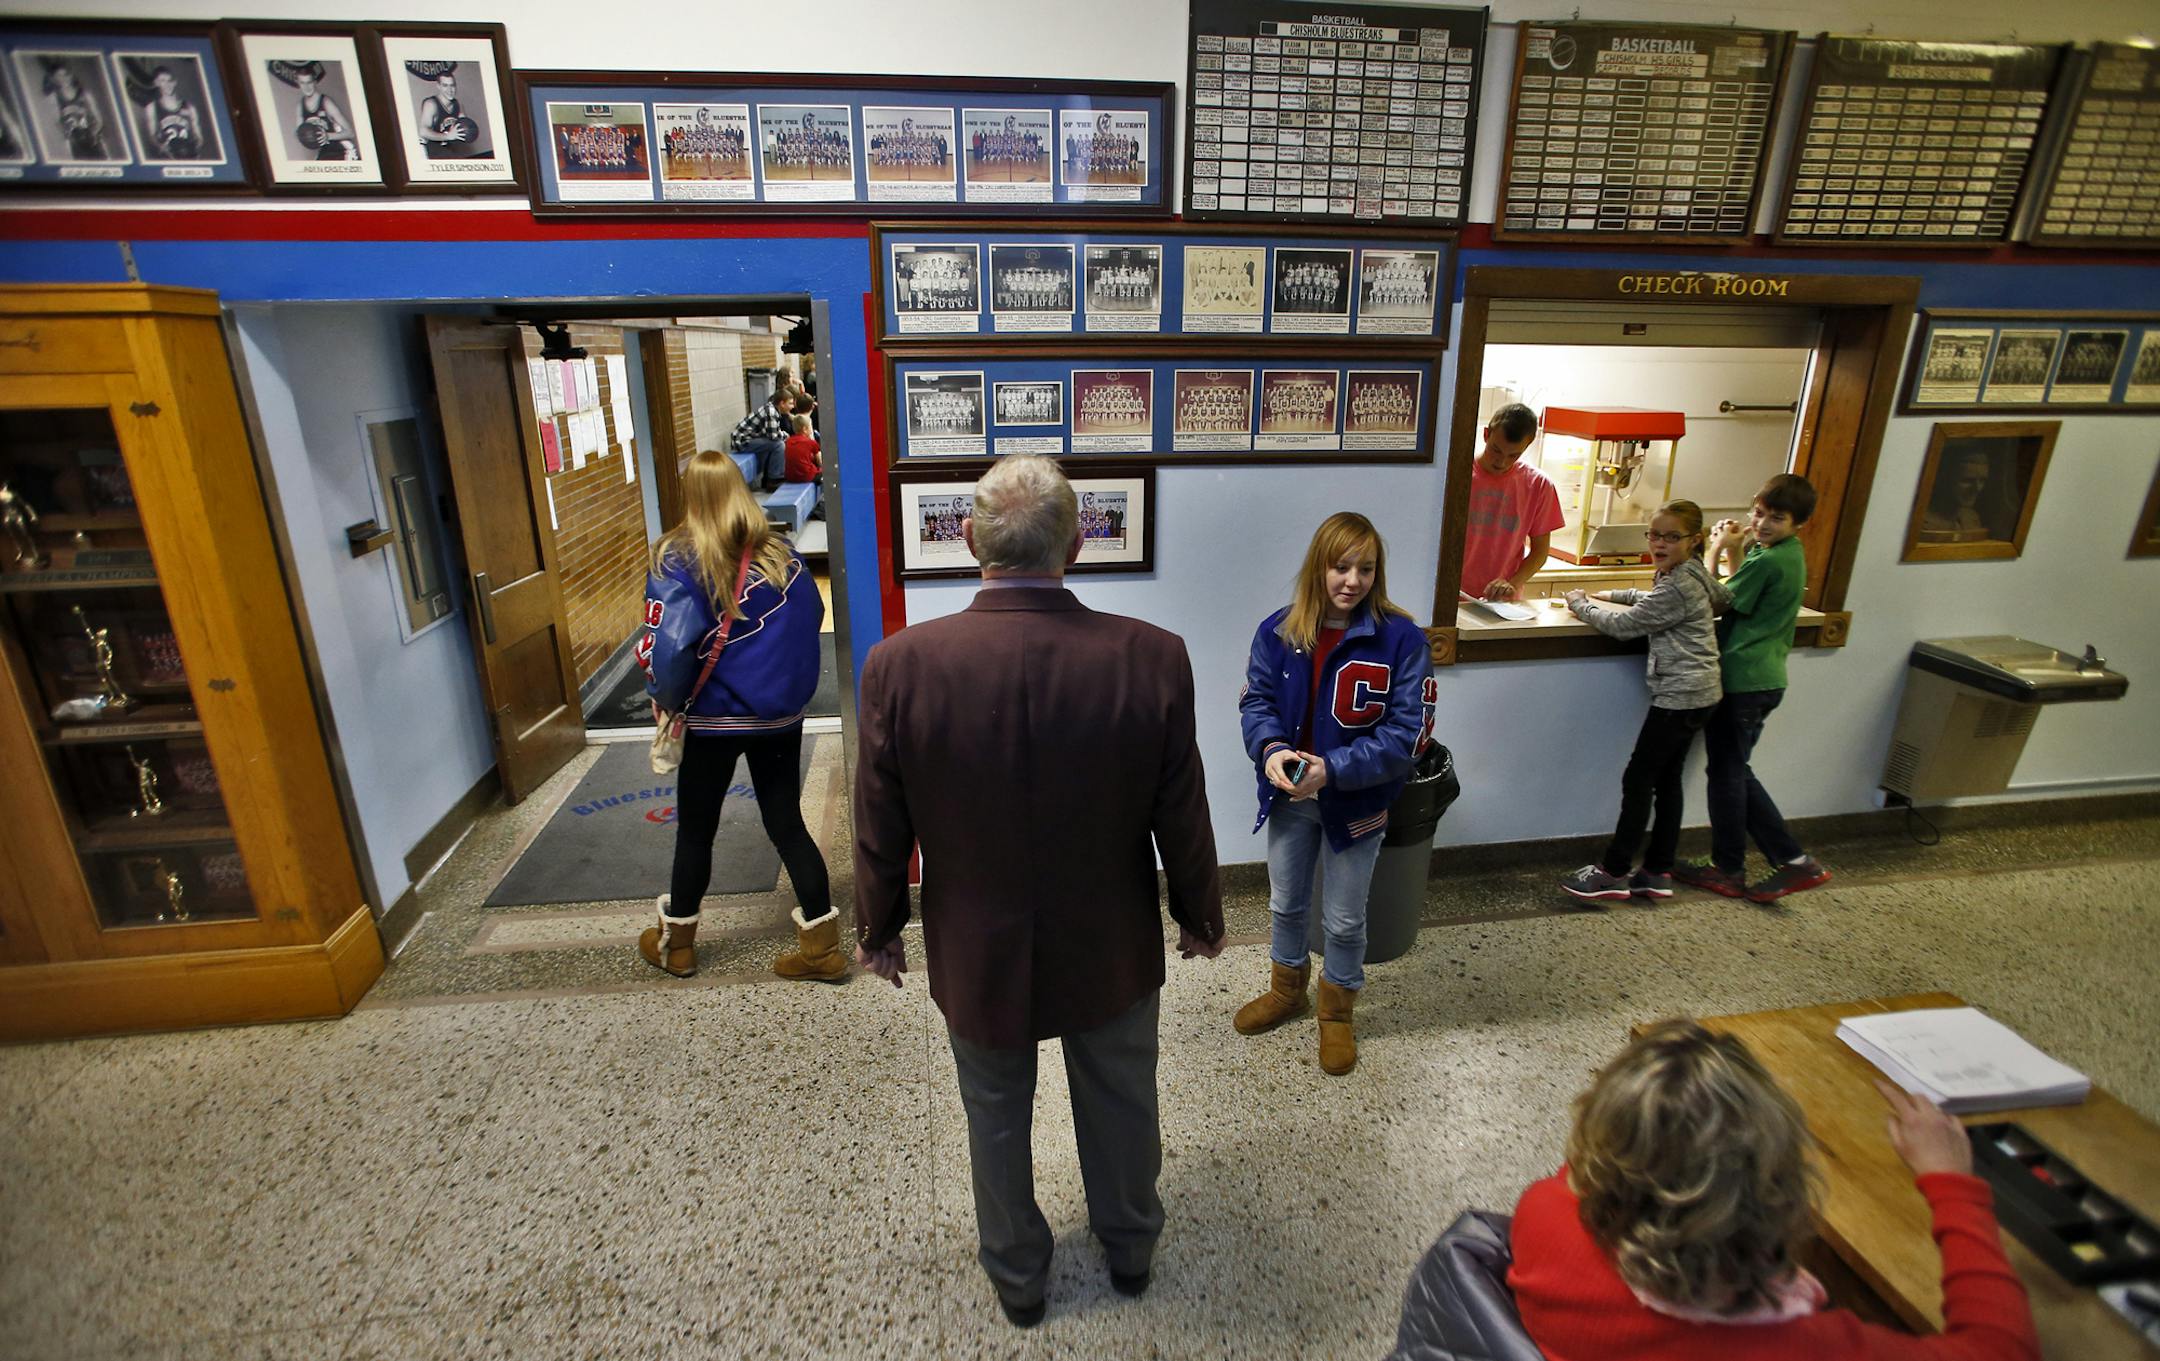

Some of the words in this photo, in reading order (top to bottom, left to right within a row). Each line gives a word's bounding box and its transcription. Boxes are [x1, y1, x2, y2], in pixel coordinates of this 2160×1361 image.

[1311, 15, 1366, 26] BASKETBALL
[1290, 24, 1329, 37] CHISHOLM
[1330, 25, 1383, 40] BLUESTREAKS
[1611, 37, 1697, 54] BASKETBALL
[1603, 53, 1647, 64] CHISHOLM
[1618, 275, 1704, 295] CHECK
[1712, 276, 1790, 296] ROOM
[1331, 660, 1391, 729] C
[570, 786, 678, 817] Bluestr
